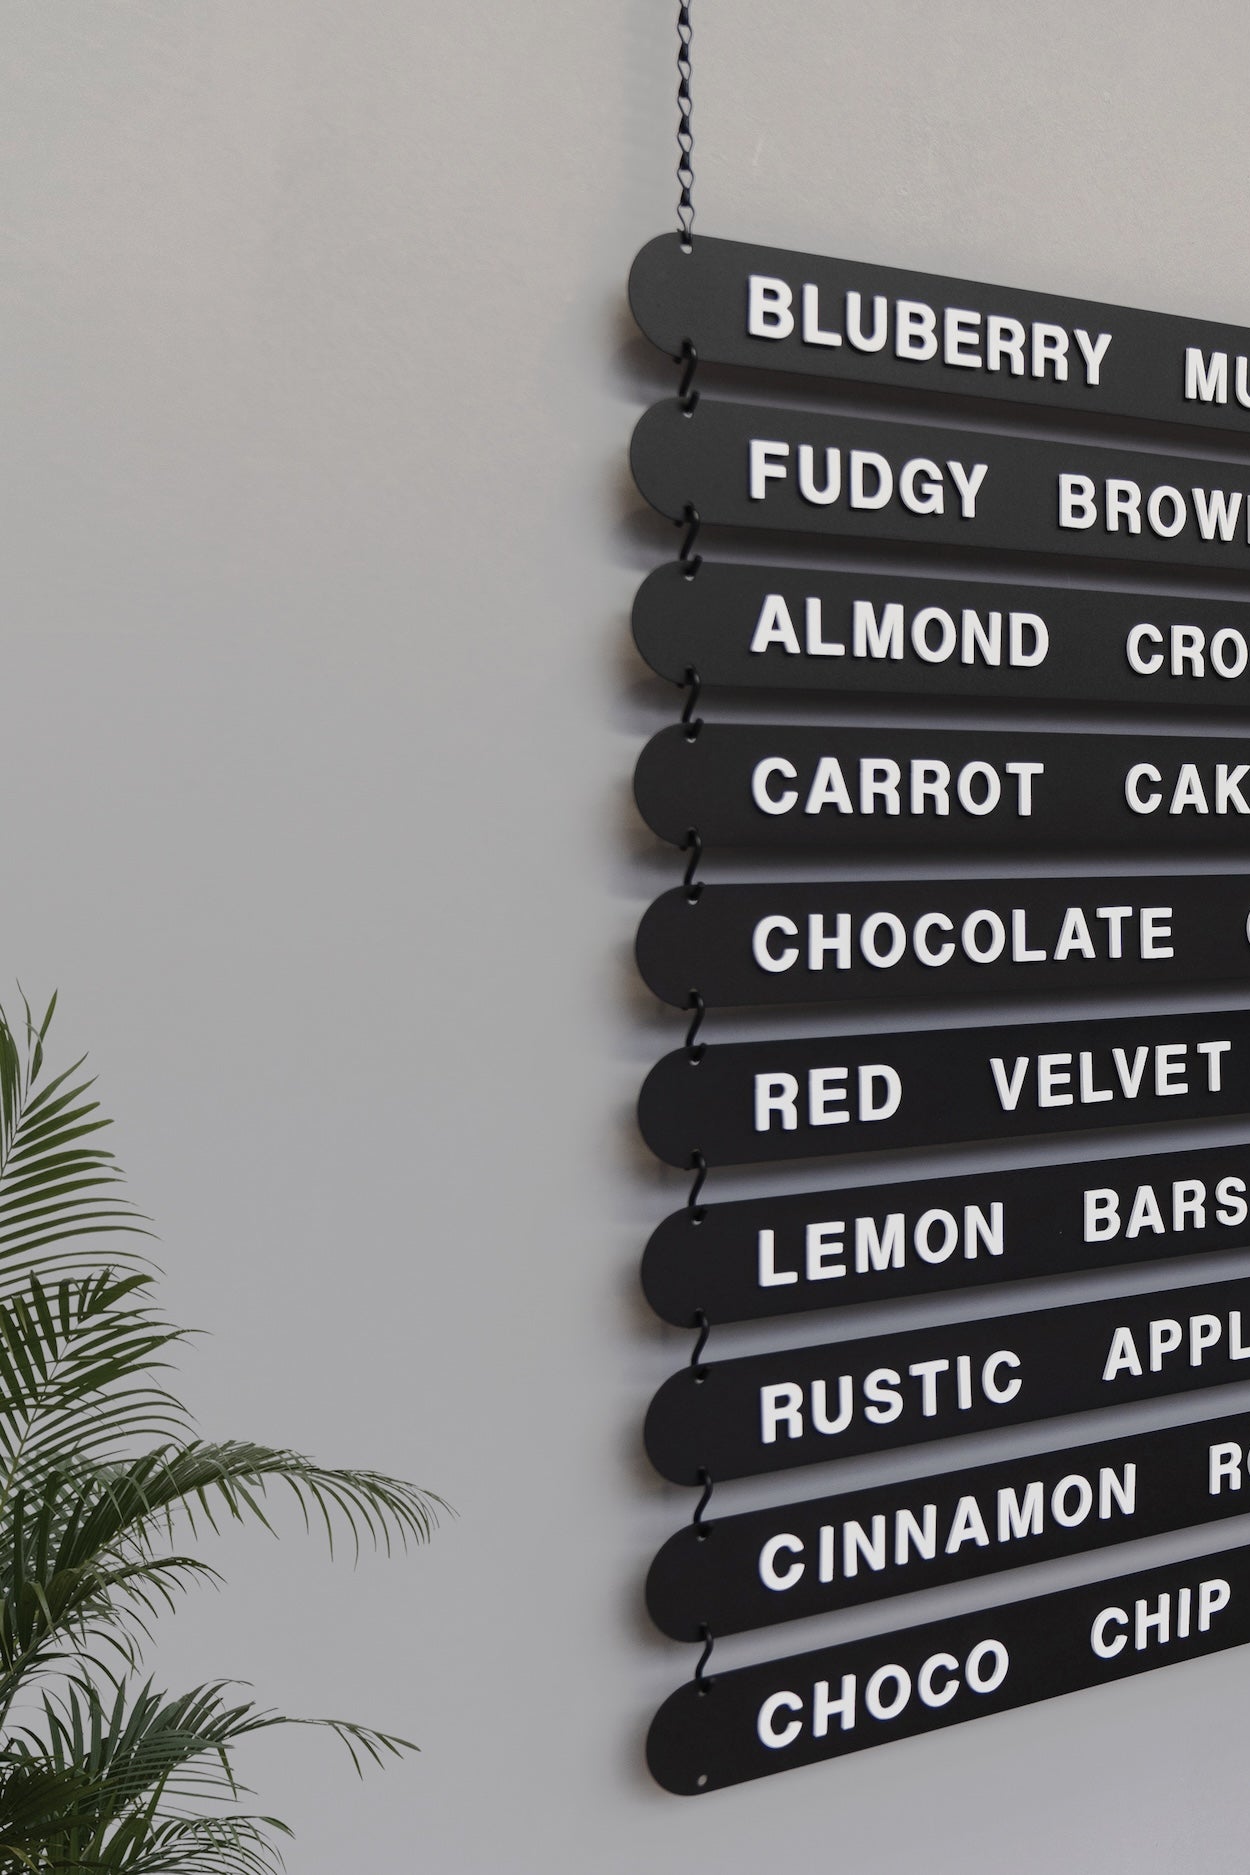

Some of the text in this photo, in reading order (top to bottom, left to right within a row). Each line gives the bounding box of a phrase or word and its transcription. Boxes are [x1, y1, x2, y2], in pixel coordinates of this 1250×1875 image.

[749, 274, 1113, 386] BLUBERRY
[750, 439, 989, 518] FUDGY
[751, 594, 1049, 667] ALMOND
[752, 757, 1044, 816] CARROT
[753, 906, 1174, 973] CHOCOLATE
[755, 1064, 902, 1132] RED
[989, 1040, 1232, 1111] VELVET
[759, 1201, 1004, 1287] LEMON
[1083, 1176, 1248, 1243] BARS
[761, 1350, 1023, 1444] RUSTIC
[759, 1463, 1137, 1591] CINNAMON
[758, 1639, 1009, 1749] CHOCO
[1090, 1578, 1231, 1659] CHIP
